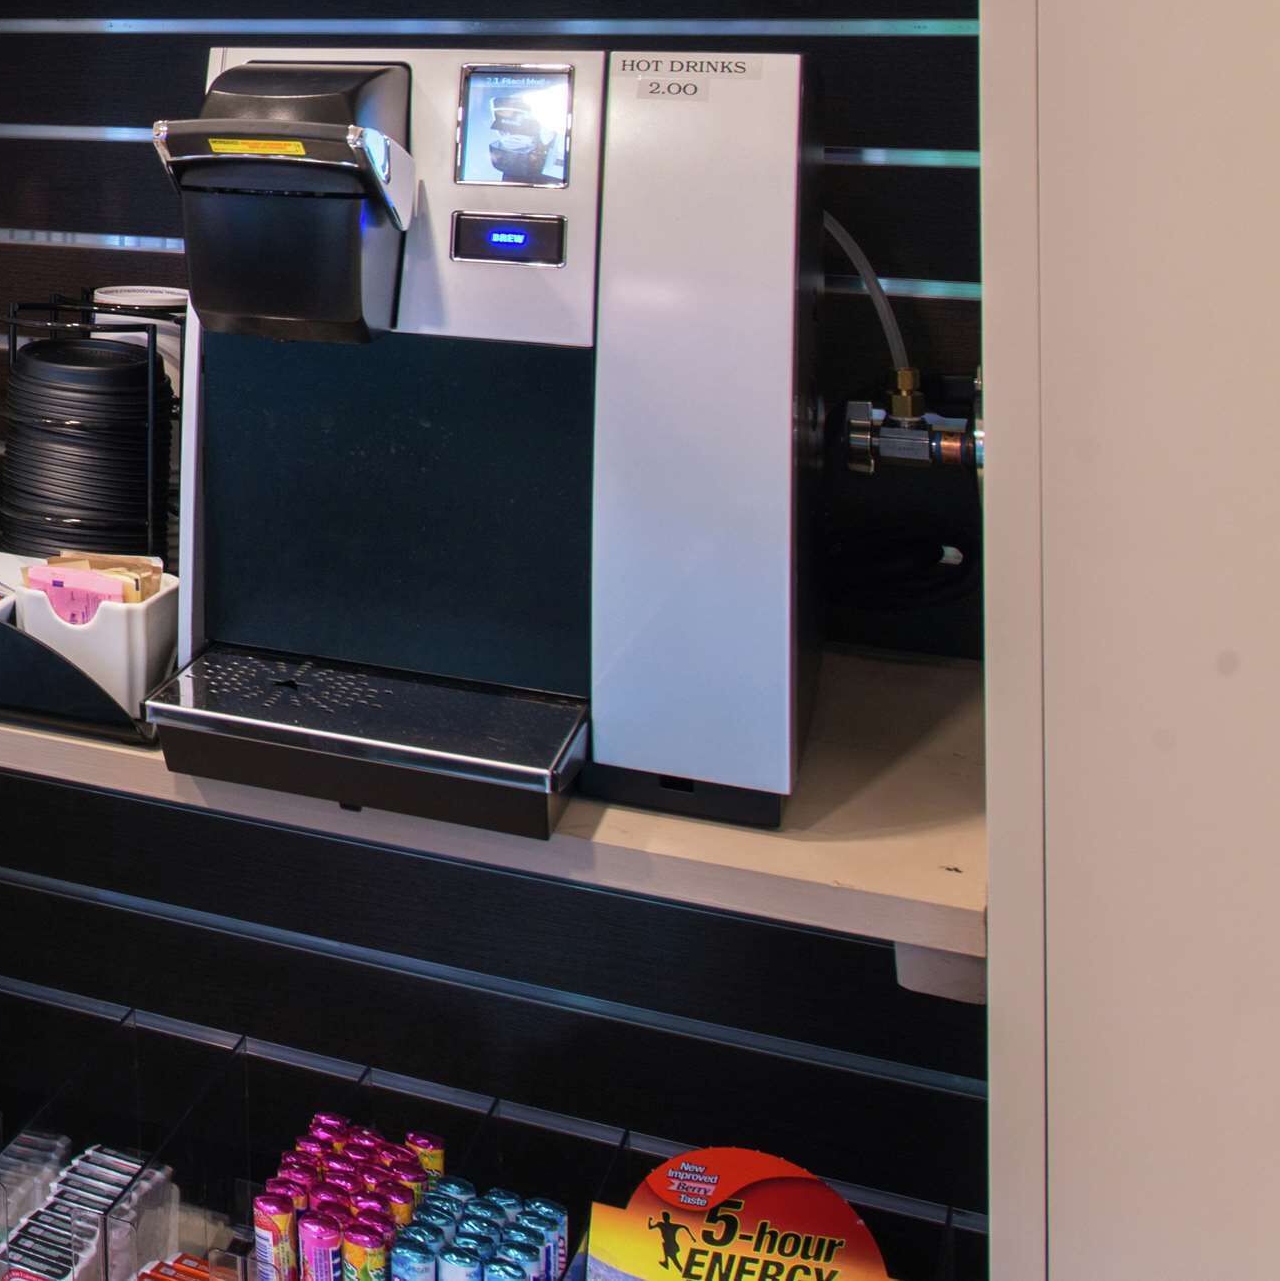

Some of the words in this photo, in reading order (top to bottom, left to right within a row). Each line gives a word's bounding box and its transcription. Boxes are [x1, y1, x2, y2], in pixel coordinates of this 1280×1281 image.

[621, 59, 664, 74] HOT
[667, 59, 747, 75] DRINKS
[648, 81, 699, 97] 2.00
[491, 232, 525, 244] BREW
[679, 1162, 705, 1173] New
[667, 1169, 718, 1185] Improved
[677, 1182, 713, 1196] Berry
[678, 1194, 708, 1207] Taste
[701, 1199, 844, 1263] 5-hour
